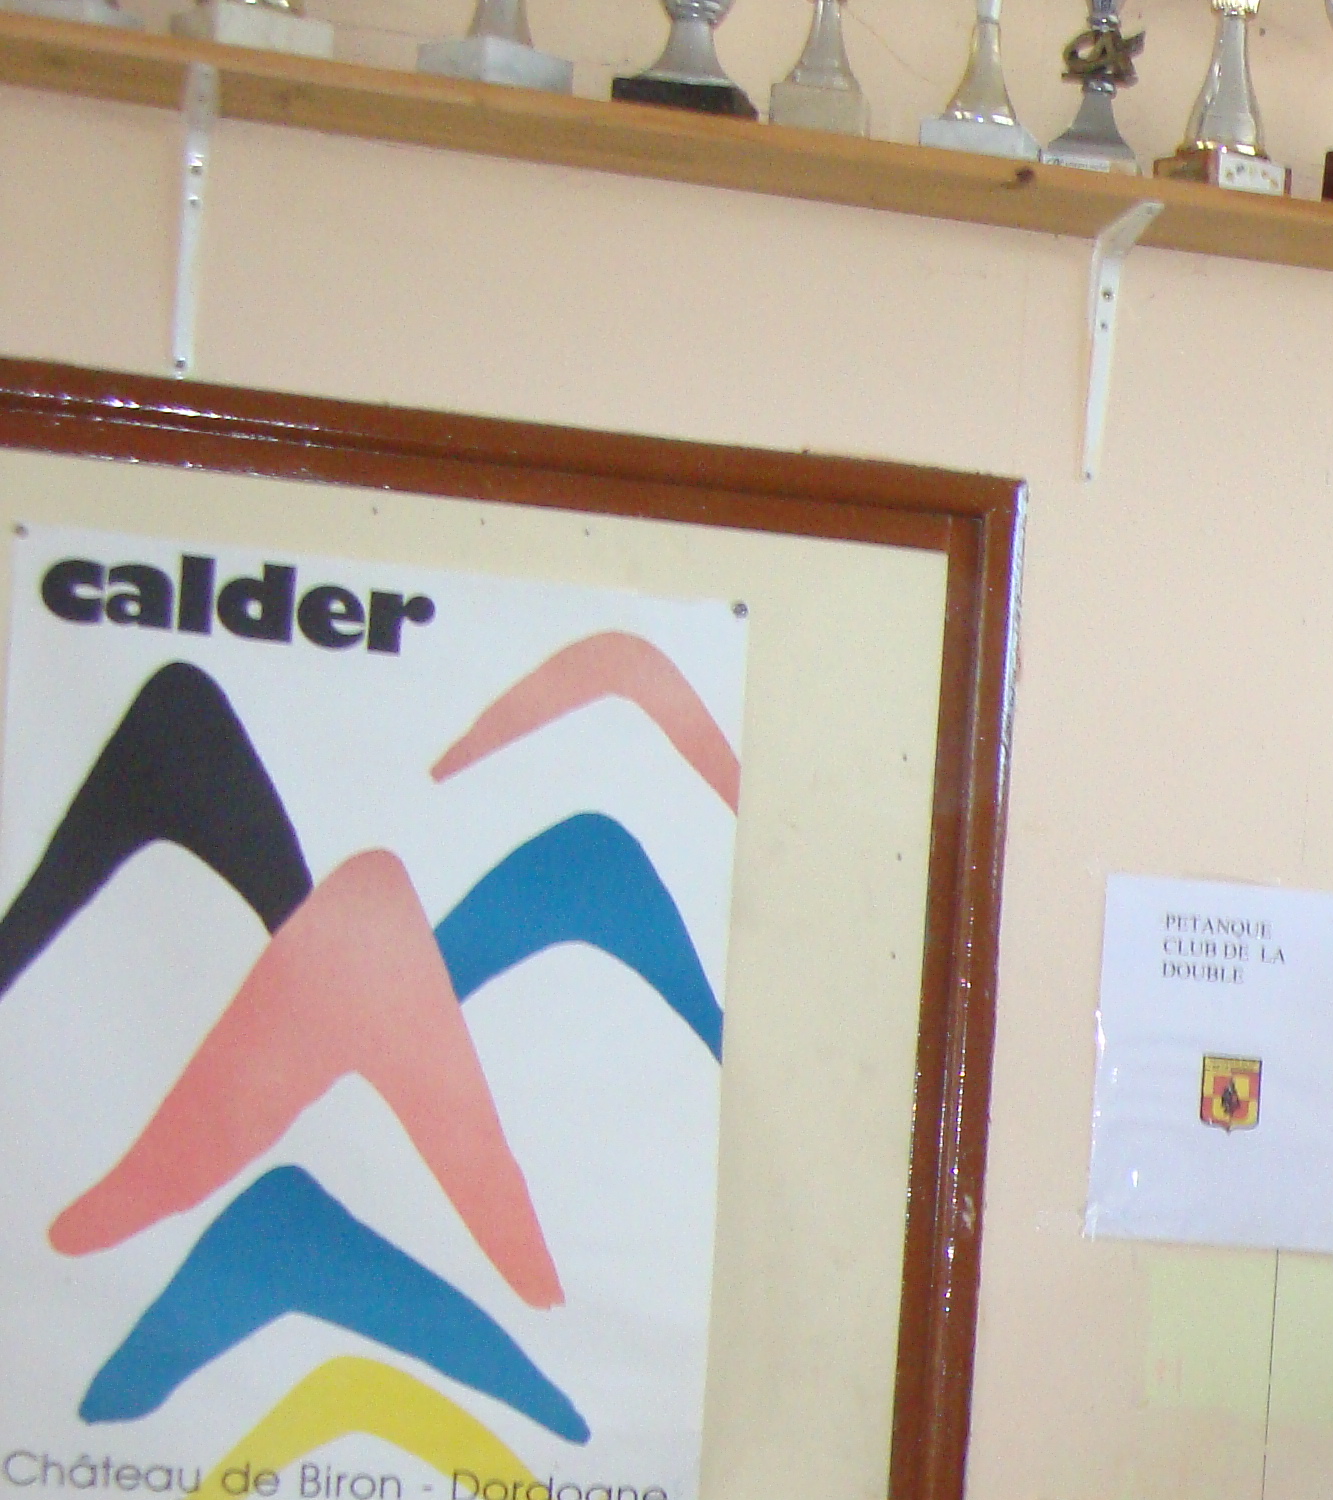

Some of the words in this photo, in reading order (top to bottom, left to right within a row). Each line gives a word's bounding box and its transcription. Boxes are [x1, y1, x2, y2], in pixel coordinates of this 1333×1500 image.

[41, 553, 436, 655] calder
[1165, 914, 1272, 939] PETANQUE
[1163, 939, 1217, 958] CLUB
[1223, 943, 1249, 961] DE
[1261, 947, 1285, 964] LA
[1162, 962, 1244, 984] DOUBLE
[3, 1449, 201, 1494] Château
[221, 1461, 281, 1497] de
[300, 1461, 403, 1500] Biron
